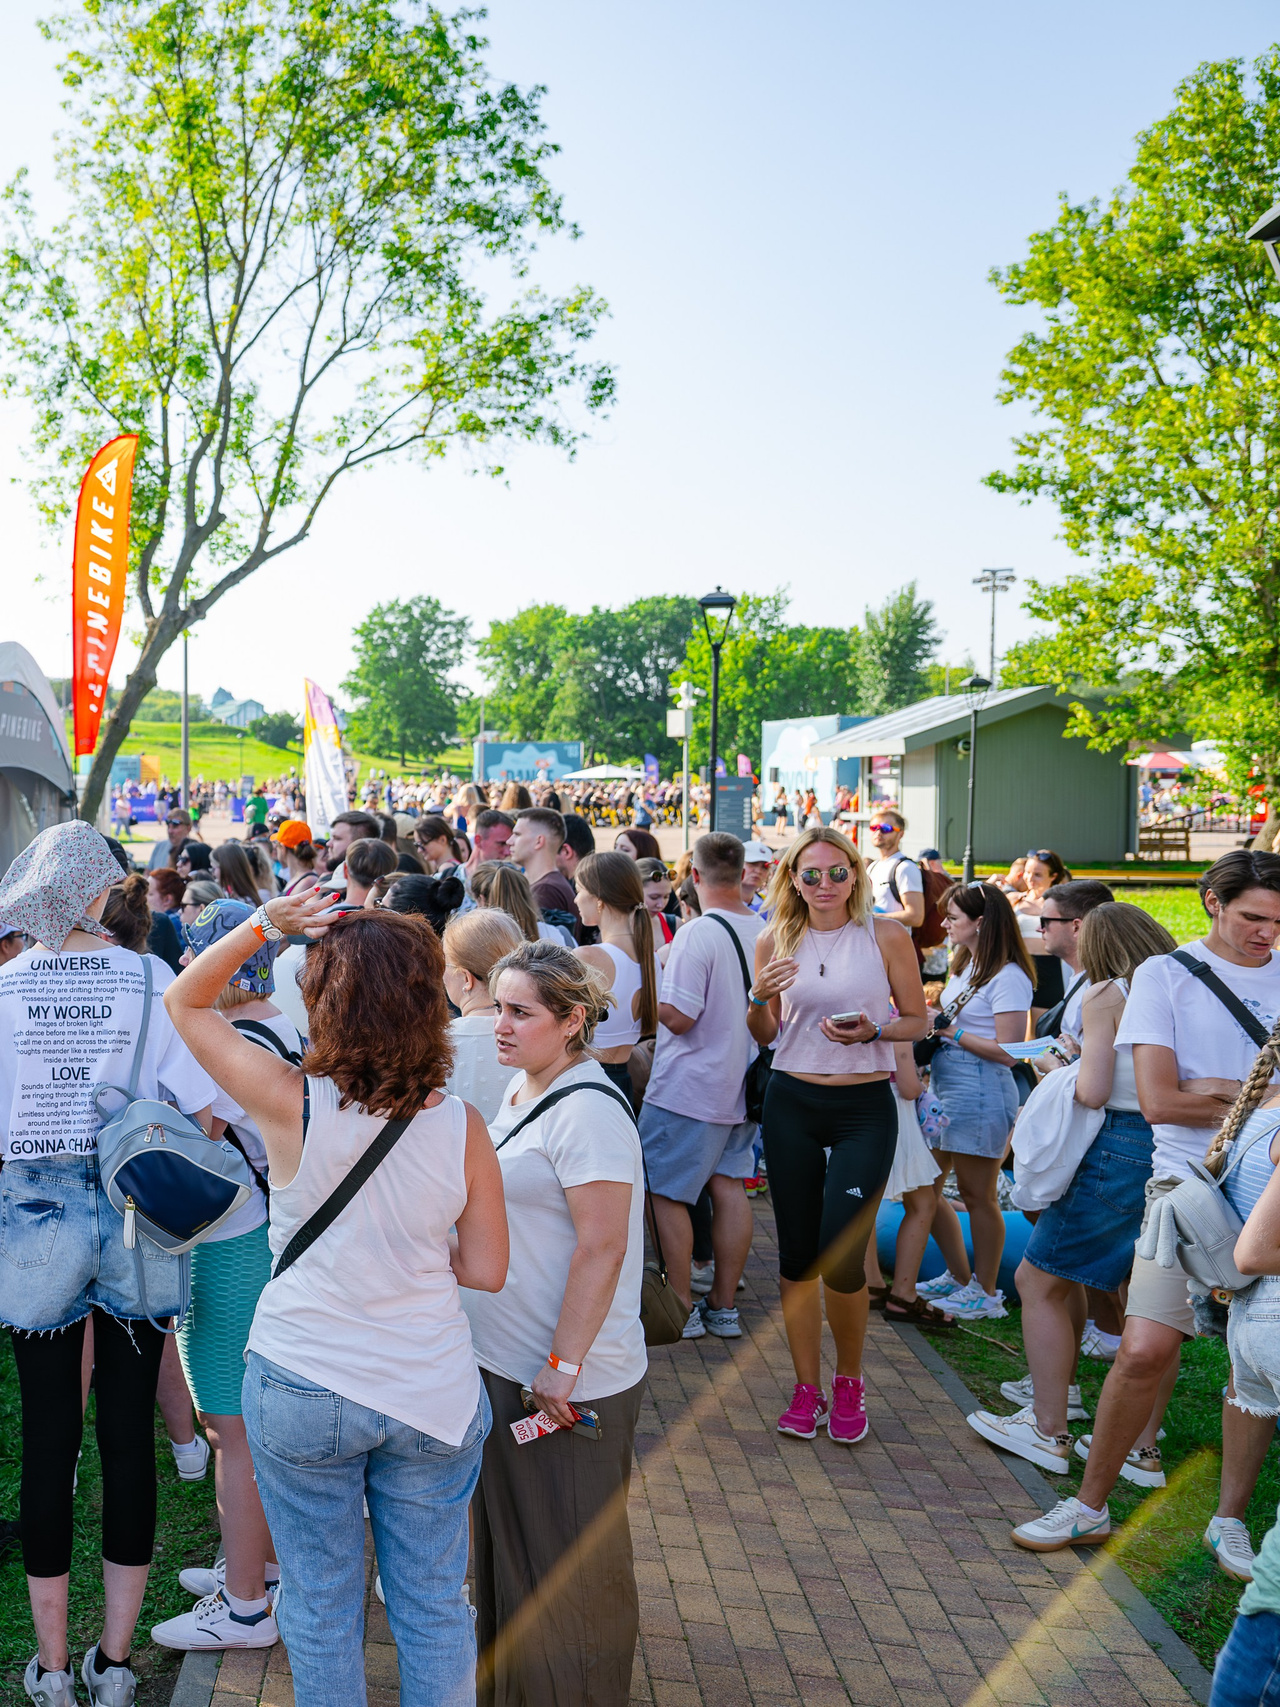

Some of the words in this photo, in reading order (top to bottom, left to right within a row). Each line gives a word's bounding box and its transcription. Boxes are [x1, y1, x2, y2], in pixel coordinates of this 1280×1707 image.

[31, 957, 111, 970] UNIVERSE
[20, 978, 38, 986] wildly
[28, 1006, 50, 1019] MY
[54, 1006, 111, 1019] WORLD
[52, 1067, 90, 1080] LOVE
[32, 1092, 54, 1100] ringing
[46, 1110, 69, 1118] undying
[10, 1139, 66, 1154] GONNA
[538, 1414, 555, 1429] 500
[516, 1424, 530, 1440] 500
